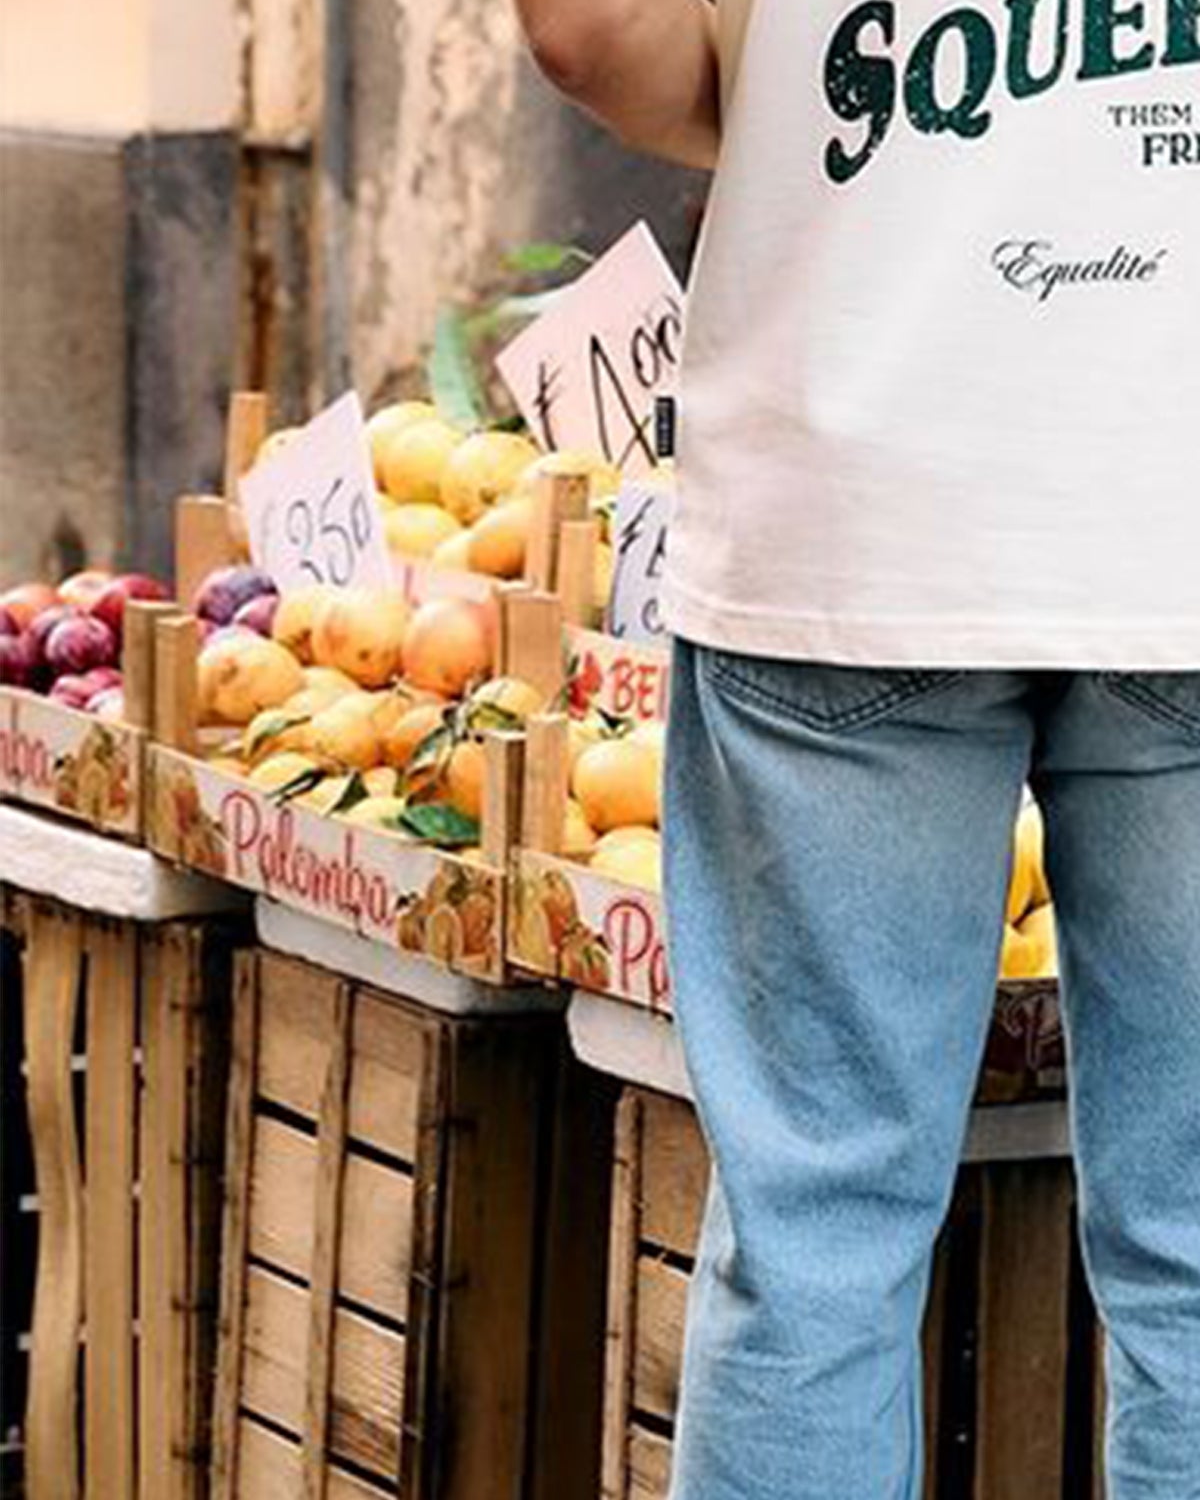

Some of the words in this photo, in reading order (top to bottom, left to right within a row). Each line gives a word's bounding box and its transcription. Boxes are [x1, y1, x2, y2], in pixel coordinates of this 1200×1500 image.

[1107, 102, 1192, 127] THEM
[991, 240, 1167, 300] Equalité
[219, 789, 400, 928] Palomba
